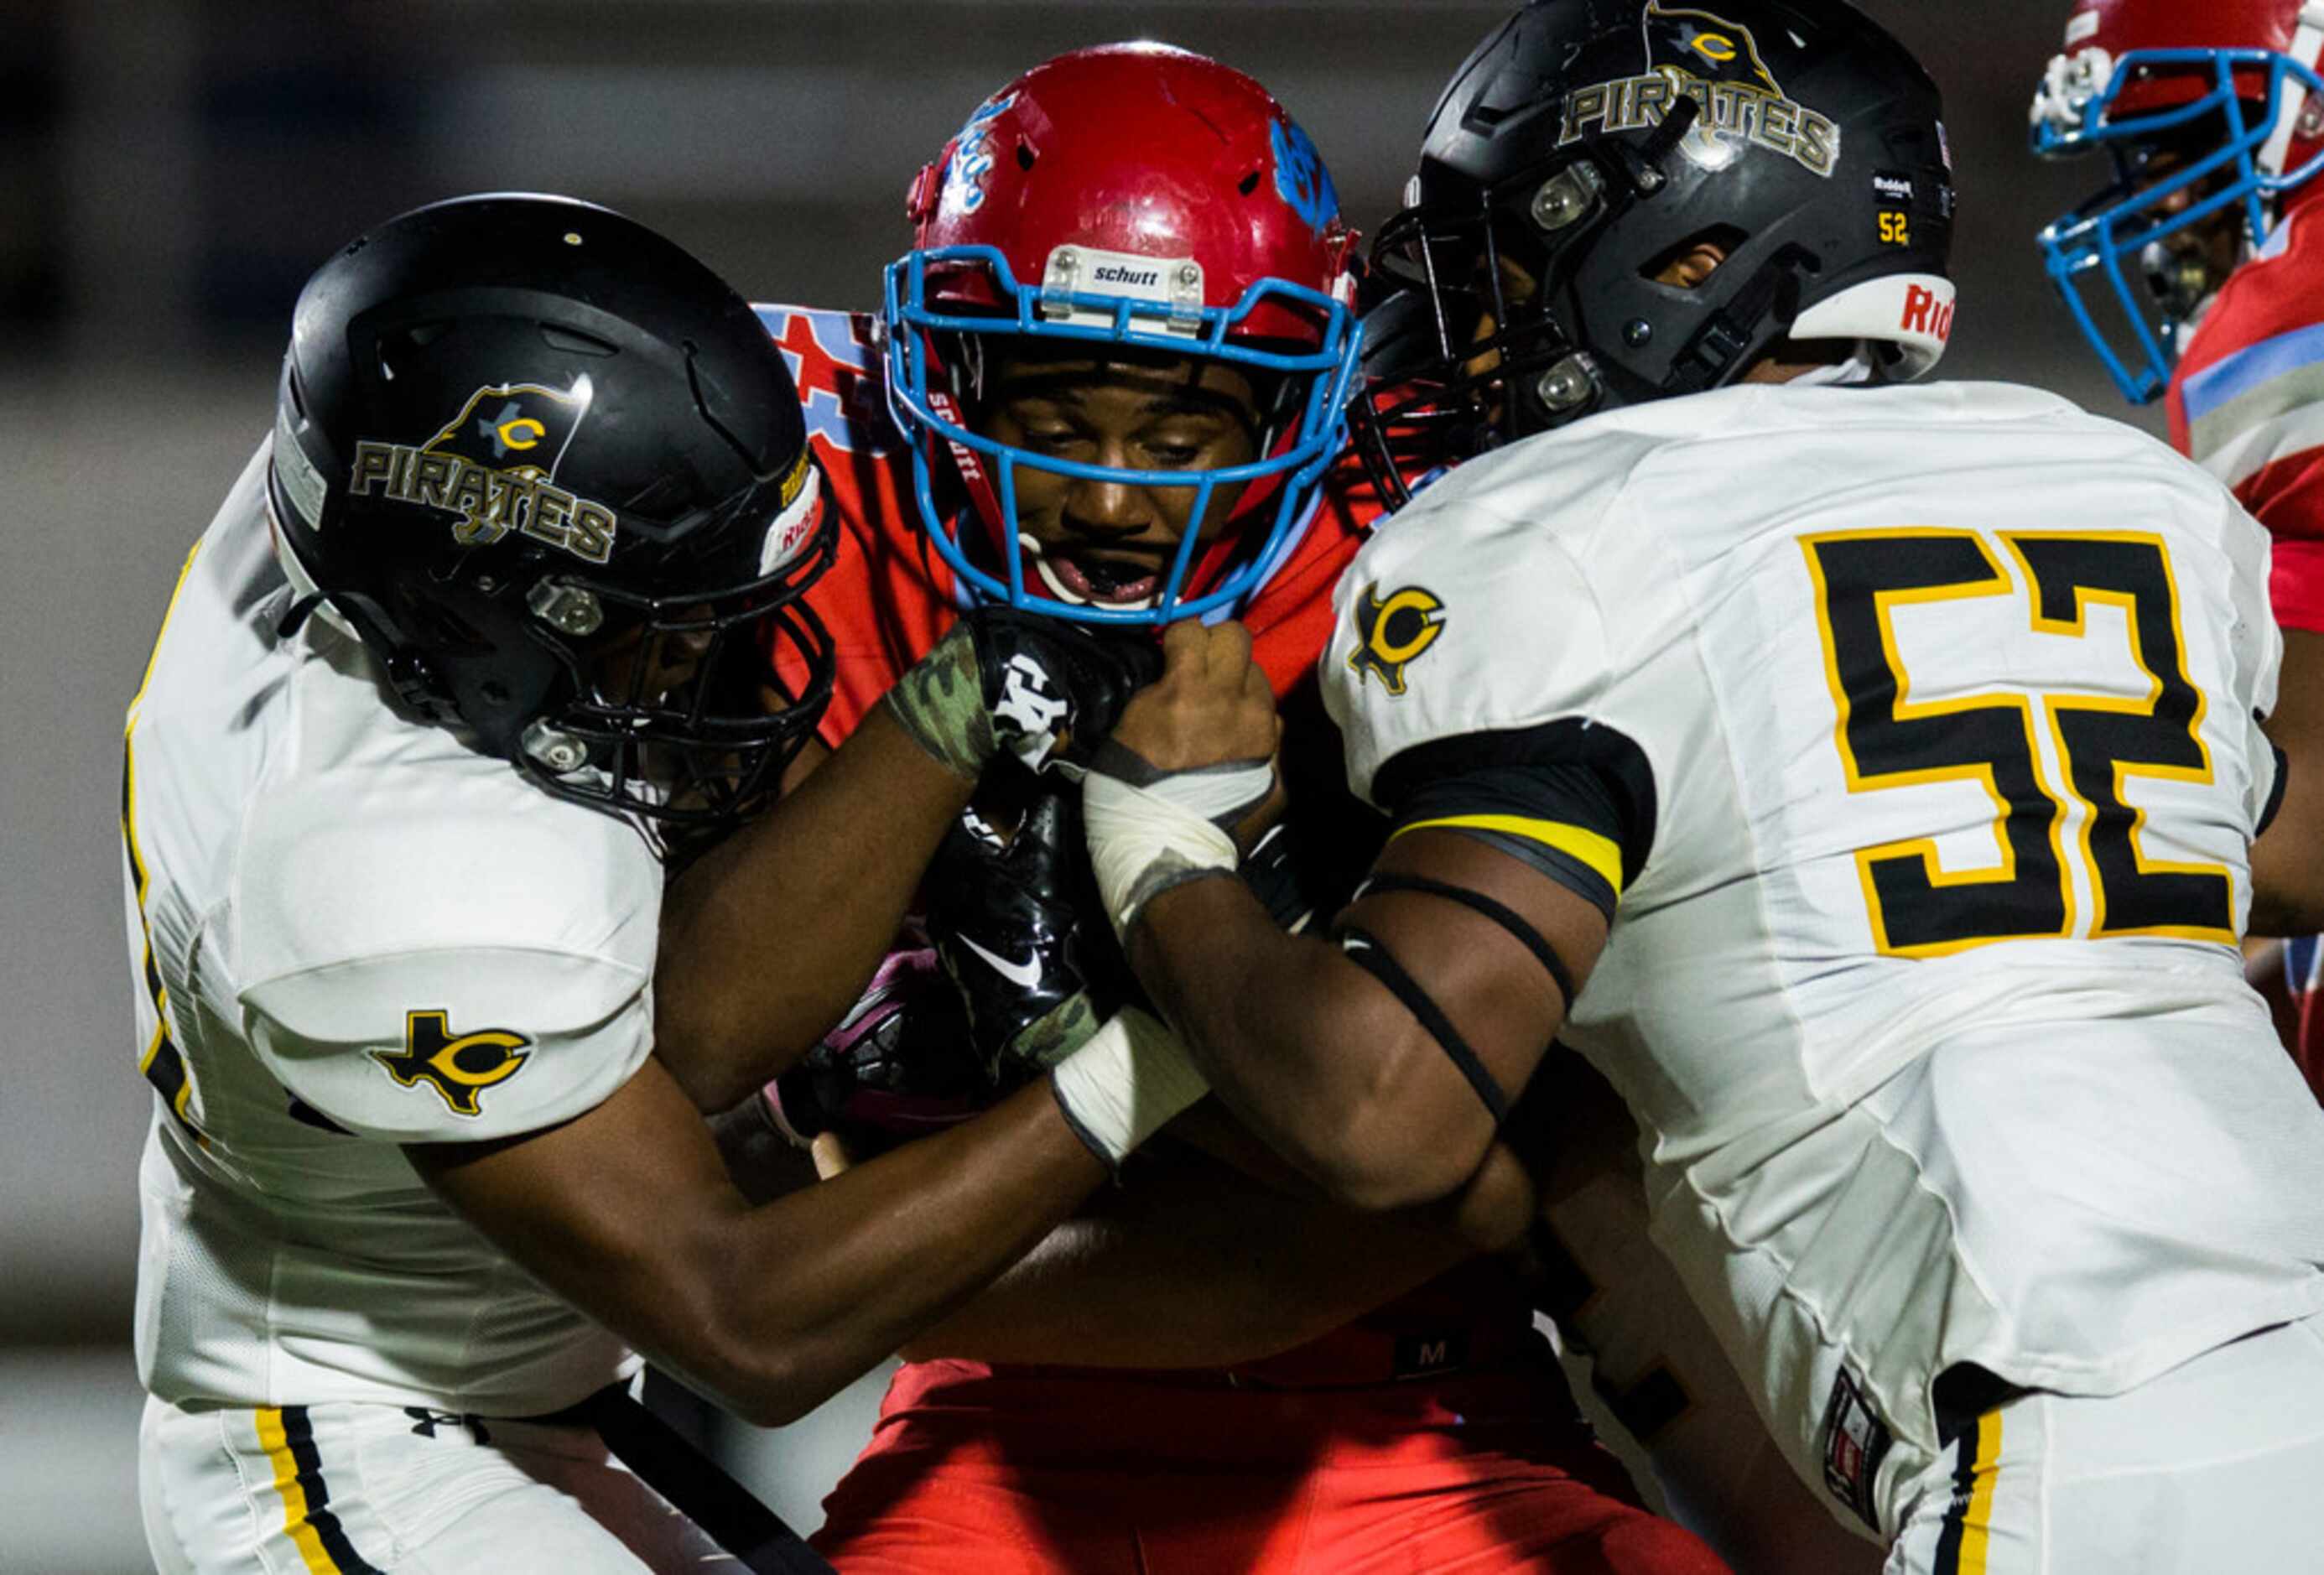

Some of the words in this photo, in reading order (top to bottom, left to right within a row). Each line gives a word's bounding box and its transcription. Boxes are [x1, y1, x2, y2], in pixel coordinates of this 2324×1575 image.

[1557, 71, 1842, 179] PIRATES
[1879, 211, 1906, 242] 52
[1094, 265, 1158, 286] schutt
[349, 439, 617, 564] PIRATES
[1794, 525, 2238, 960] 52
[1417, 1338, 1447, 1366] M
